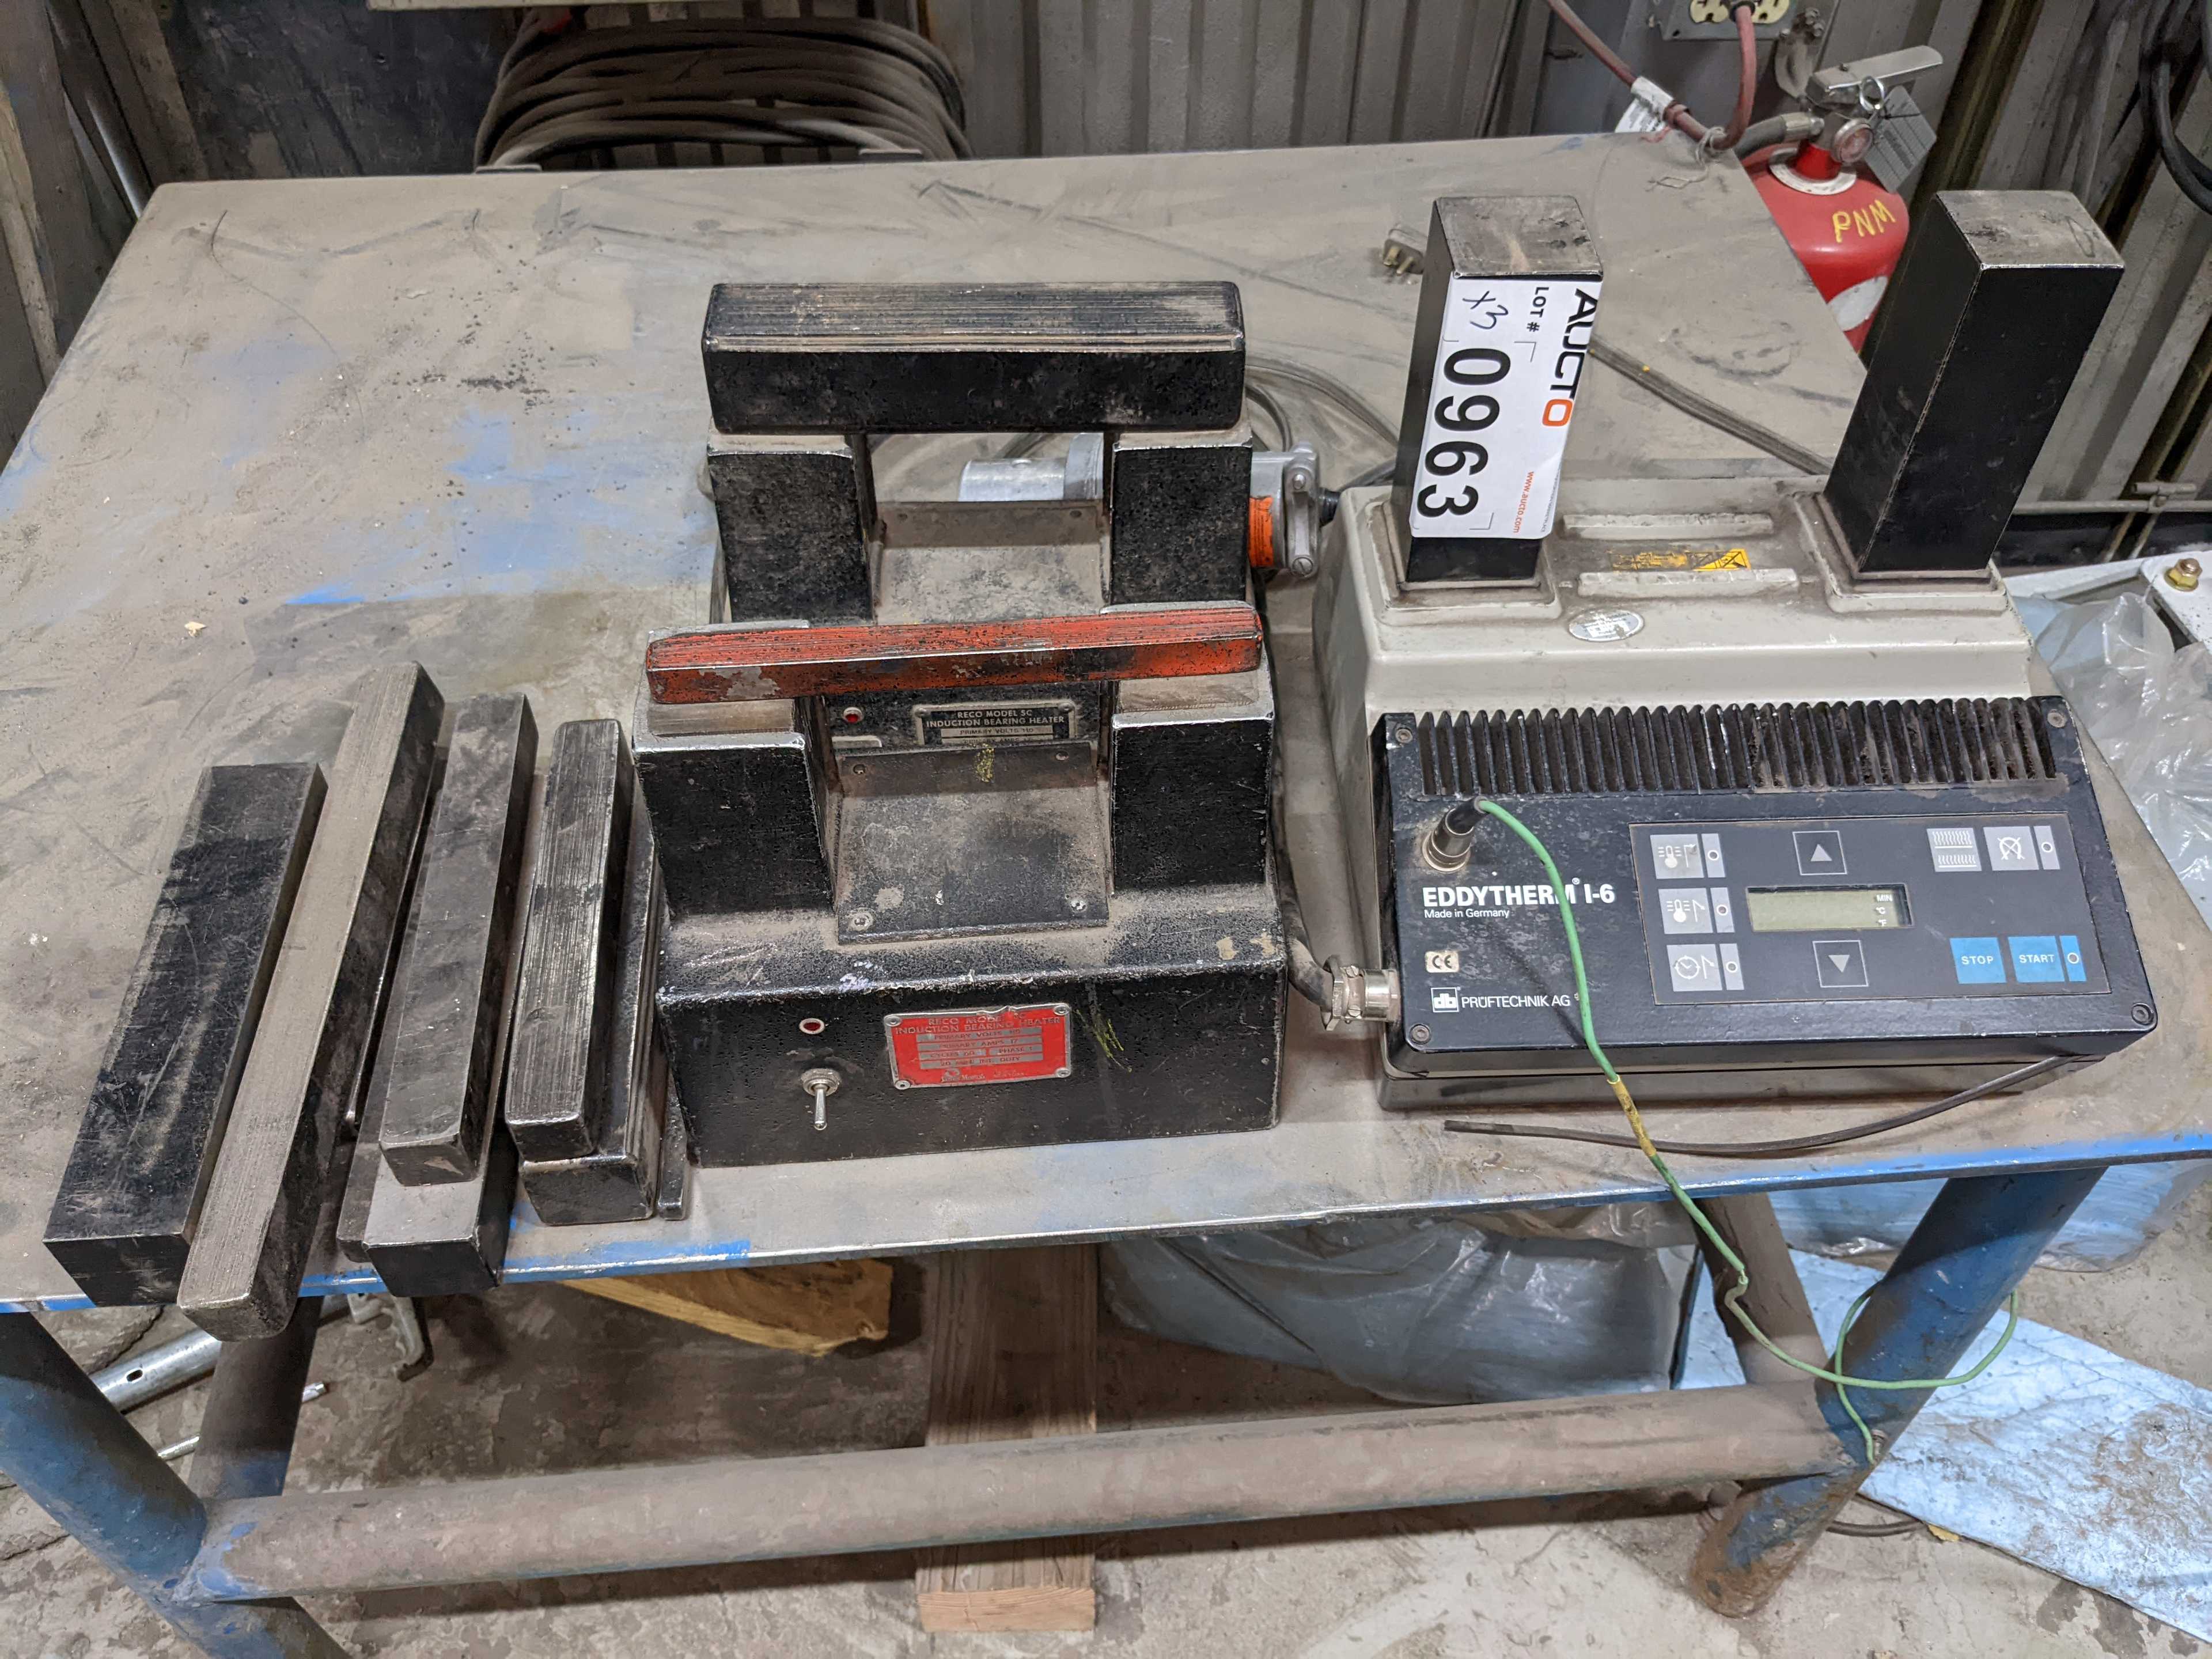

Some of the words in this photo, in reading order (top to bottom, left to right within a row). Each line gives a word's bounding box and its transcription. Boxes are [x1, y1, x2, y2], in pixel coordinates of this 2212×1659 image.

[1832, 199, 1896, 243] PNM
[1530, 287, 1550, 317] LOT
[1527, 321, 1540, 332] #
[1541, 288, 1599, 427] AUCTO
[1417, 347, 1511, 518] 0963
[1513, 471, 1535, 533] www.aucto.com
[986, 710, 1017, 718] MODEL
[926, 719, 980, 728] INDUCTION
[984, 718, 1026, 726] BEARING
[1029, 716, 1065, 724] HEATER
[1423, 884, 1576, 907] EDDYTHERM
[1584, 884, 1615, 903] I-6
[1424, 909, 1452, 918] Made
[1454, 908, 1463, 917] in
[1465, 908, 1510, 919] Germany
[1961, 955, 1994, 965] STOP
[2018, 953, 2055, 964] START
[1461, 995, 1550, 1008] PRÜFTECHNIK
[1551, 994, 1571, 1006] AG
[966, 1015, 1003, 1024] MODE
[896, 1025, 959, 1035] INDUCTION
